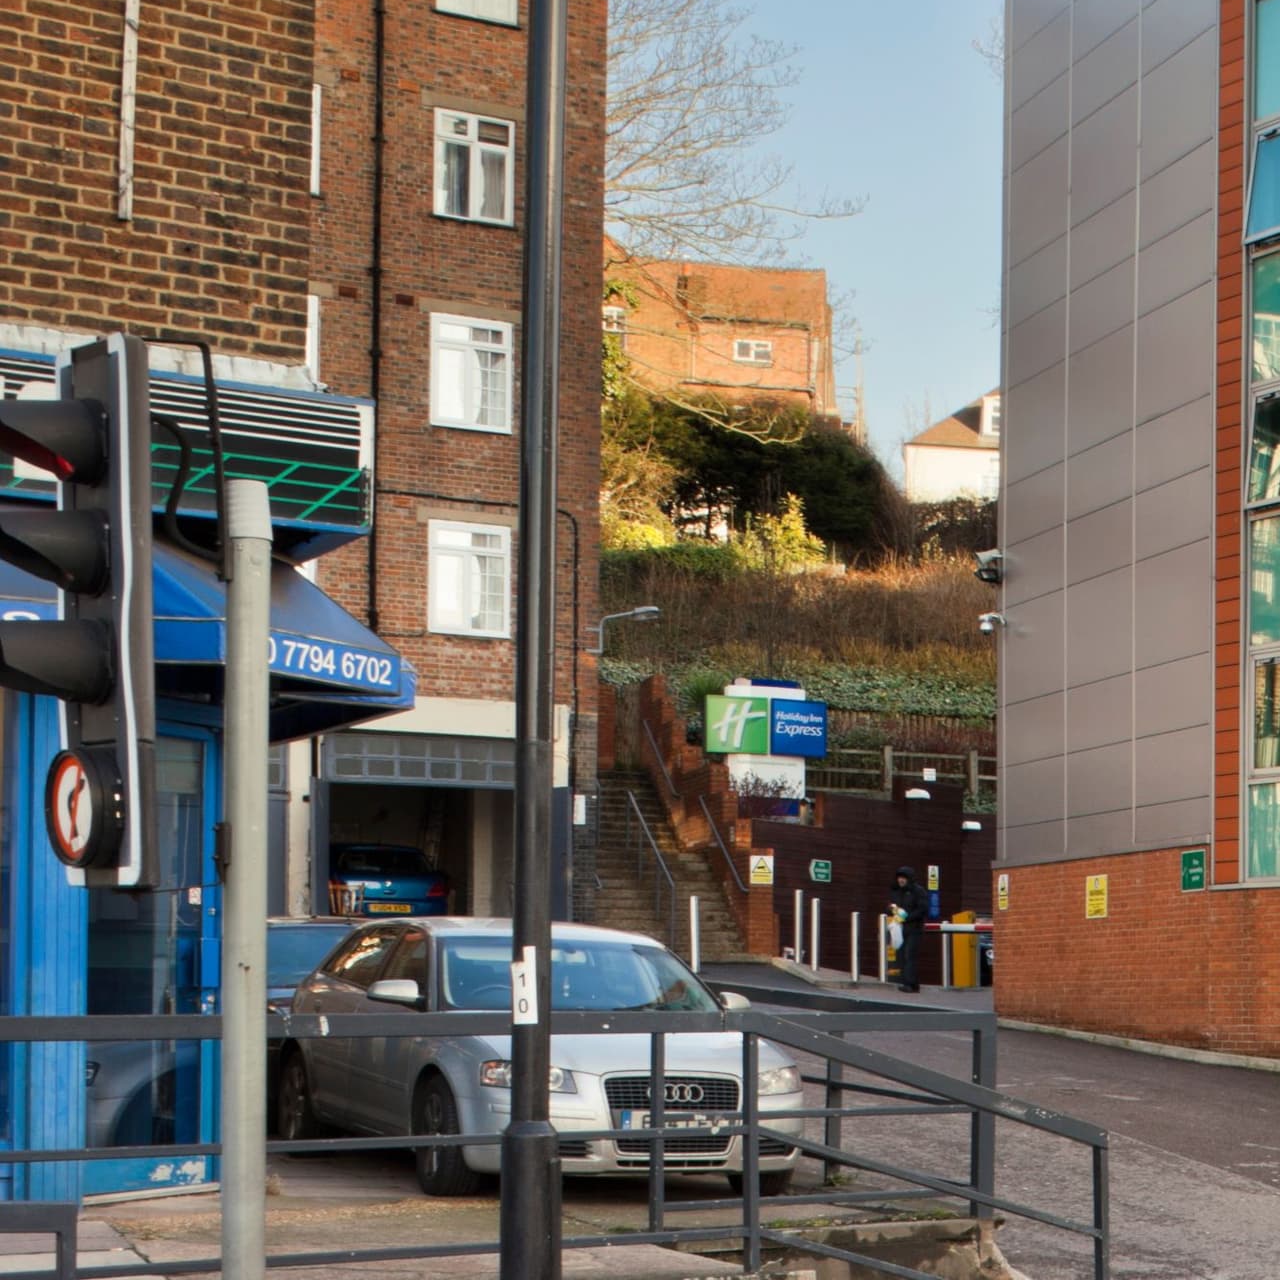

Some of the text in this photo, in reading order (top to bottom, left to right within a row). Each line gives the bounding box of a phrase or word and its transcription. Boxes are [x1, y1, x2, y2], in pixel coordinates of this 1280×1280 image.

[282, 639, 336, 675] 7794
[341, 651, 392, 686] 6702
[775, 711, 823, 724] Holiday Inn
[775, 721, 823, 737] Express
